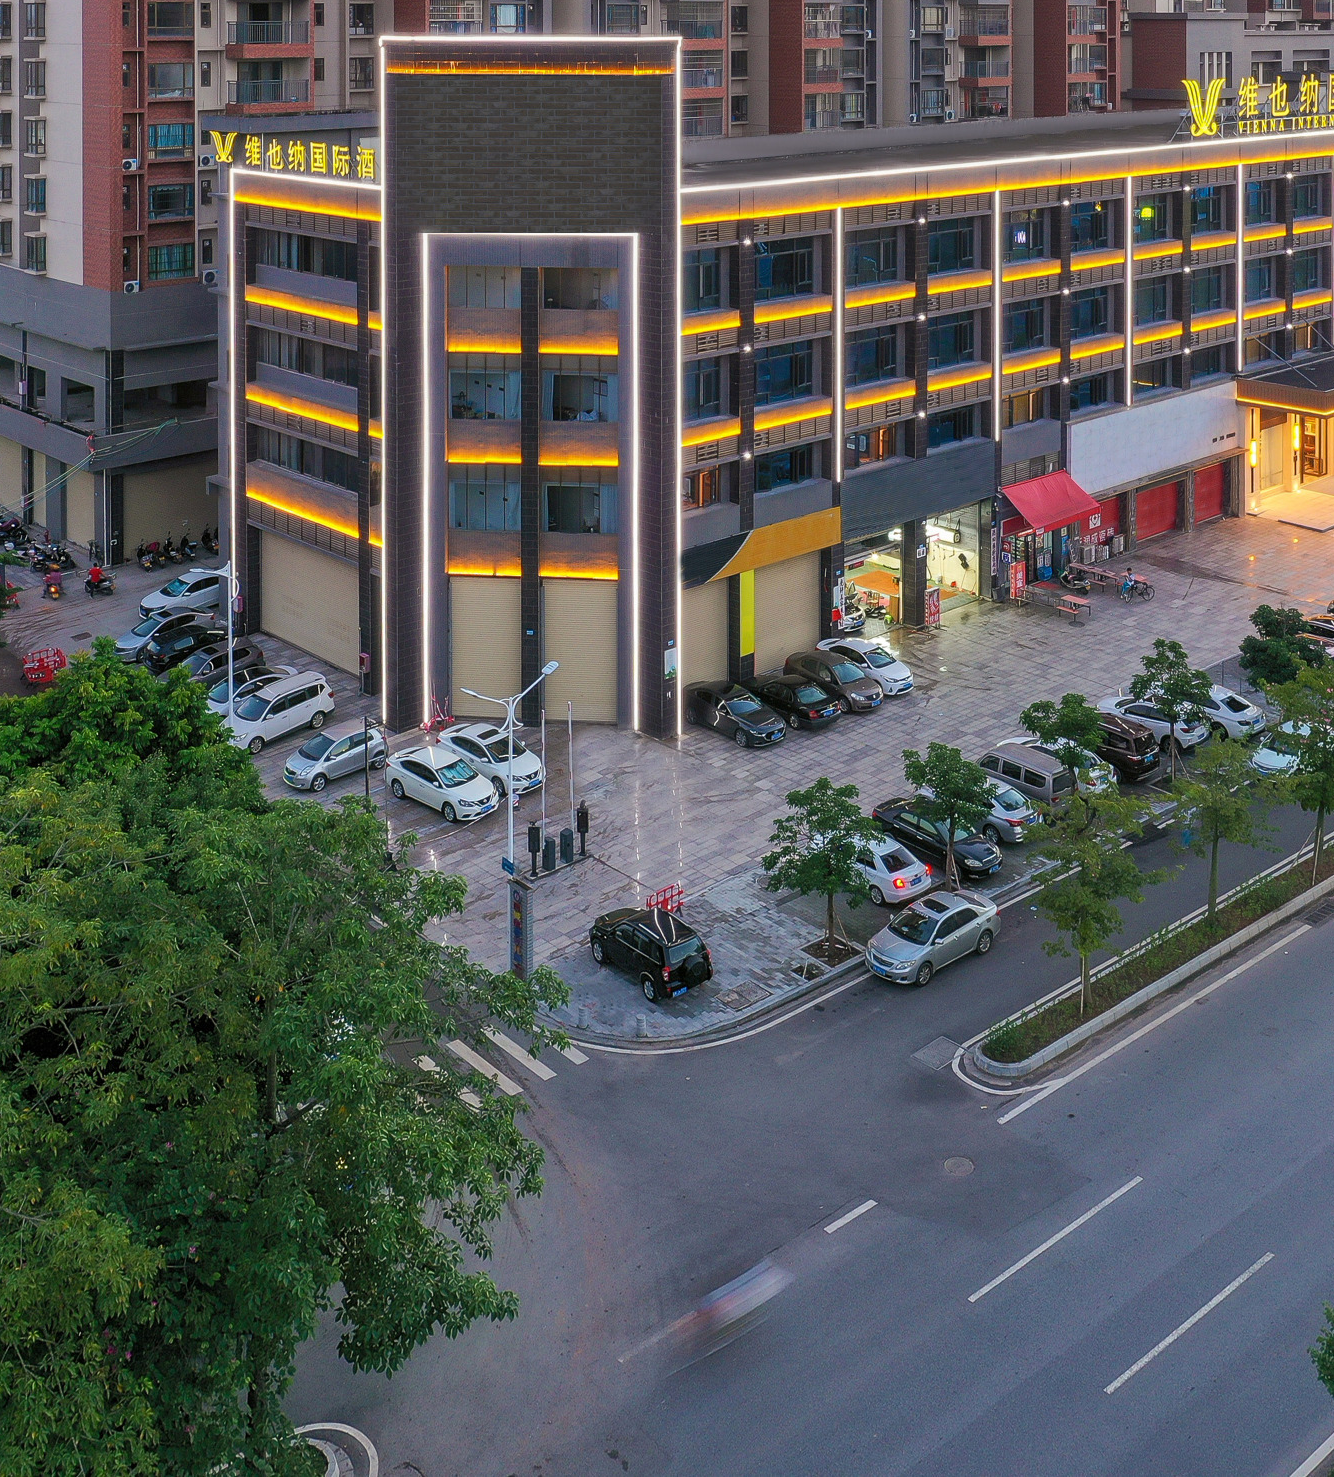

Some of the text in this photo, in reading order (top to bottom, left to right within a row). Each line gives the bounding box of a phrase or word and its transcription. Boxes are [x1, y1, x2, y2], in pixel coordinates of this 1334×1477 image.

[1238, 119, 1286, 134] VIENNA
[244, 134, 376, 180] 维也纳国际酒
